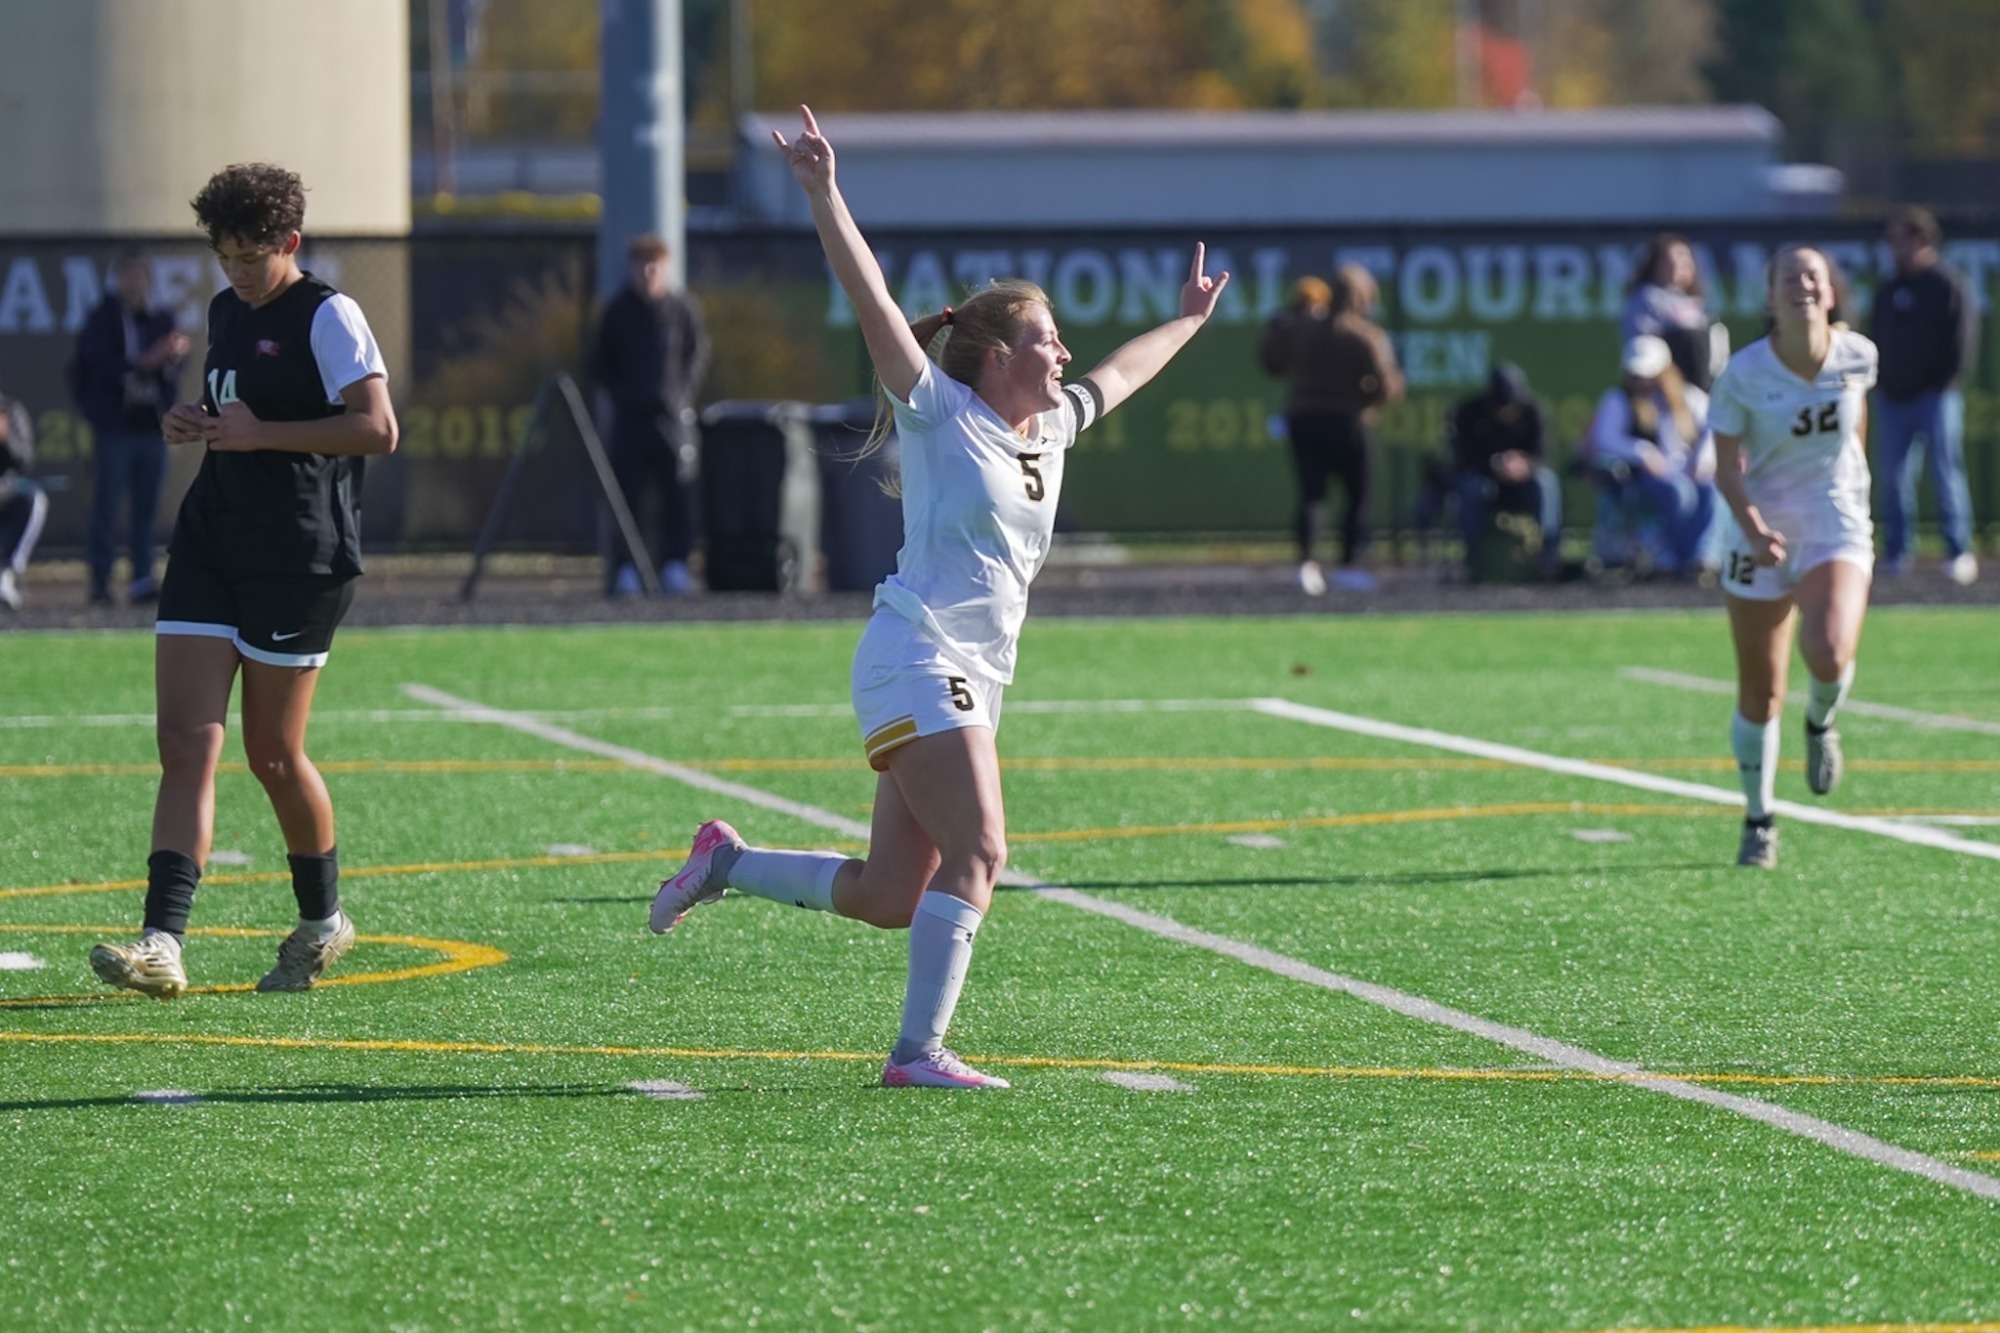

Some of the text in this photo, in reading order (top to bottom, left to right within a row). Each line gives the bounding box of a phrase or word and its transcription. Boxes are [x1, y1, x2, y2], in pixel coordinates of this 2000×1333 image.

[1389, 330, 1489, 388] EN
[207, 368, 241, 414] 14
[1791, 402, 1839, 437] 32
[1016, 453, 1045, 502] 5
[1728, 550, 1754, 585] 12
[949, 676, 974, 711] 5
